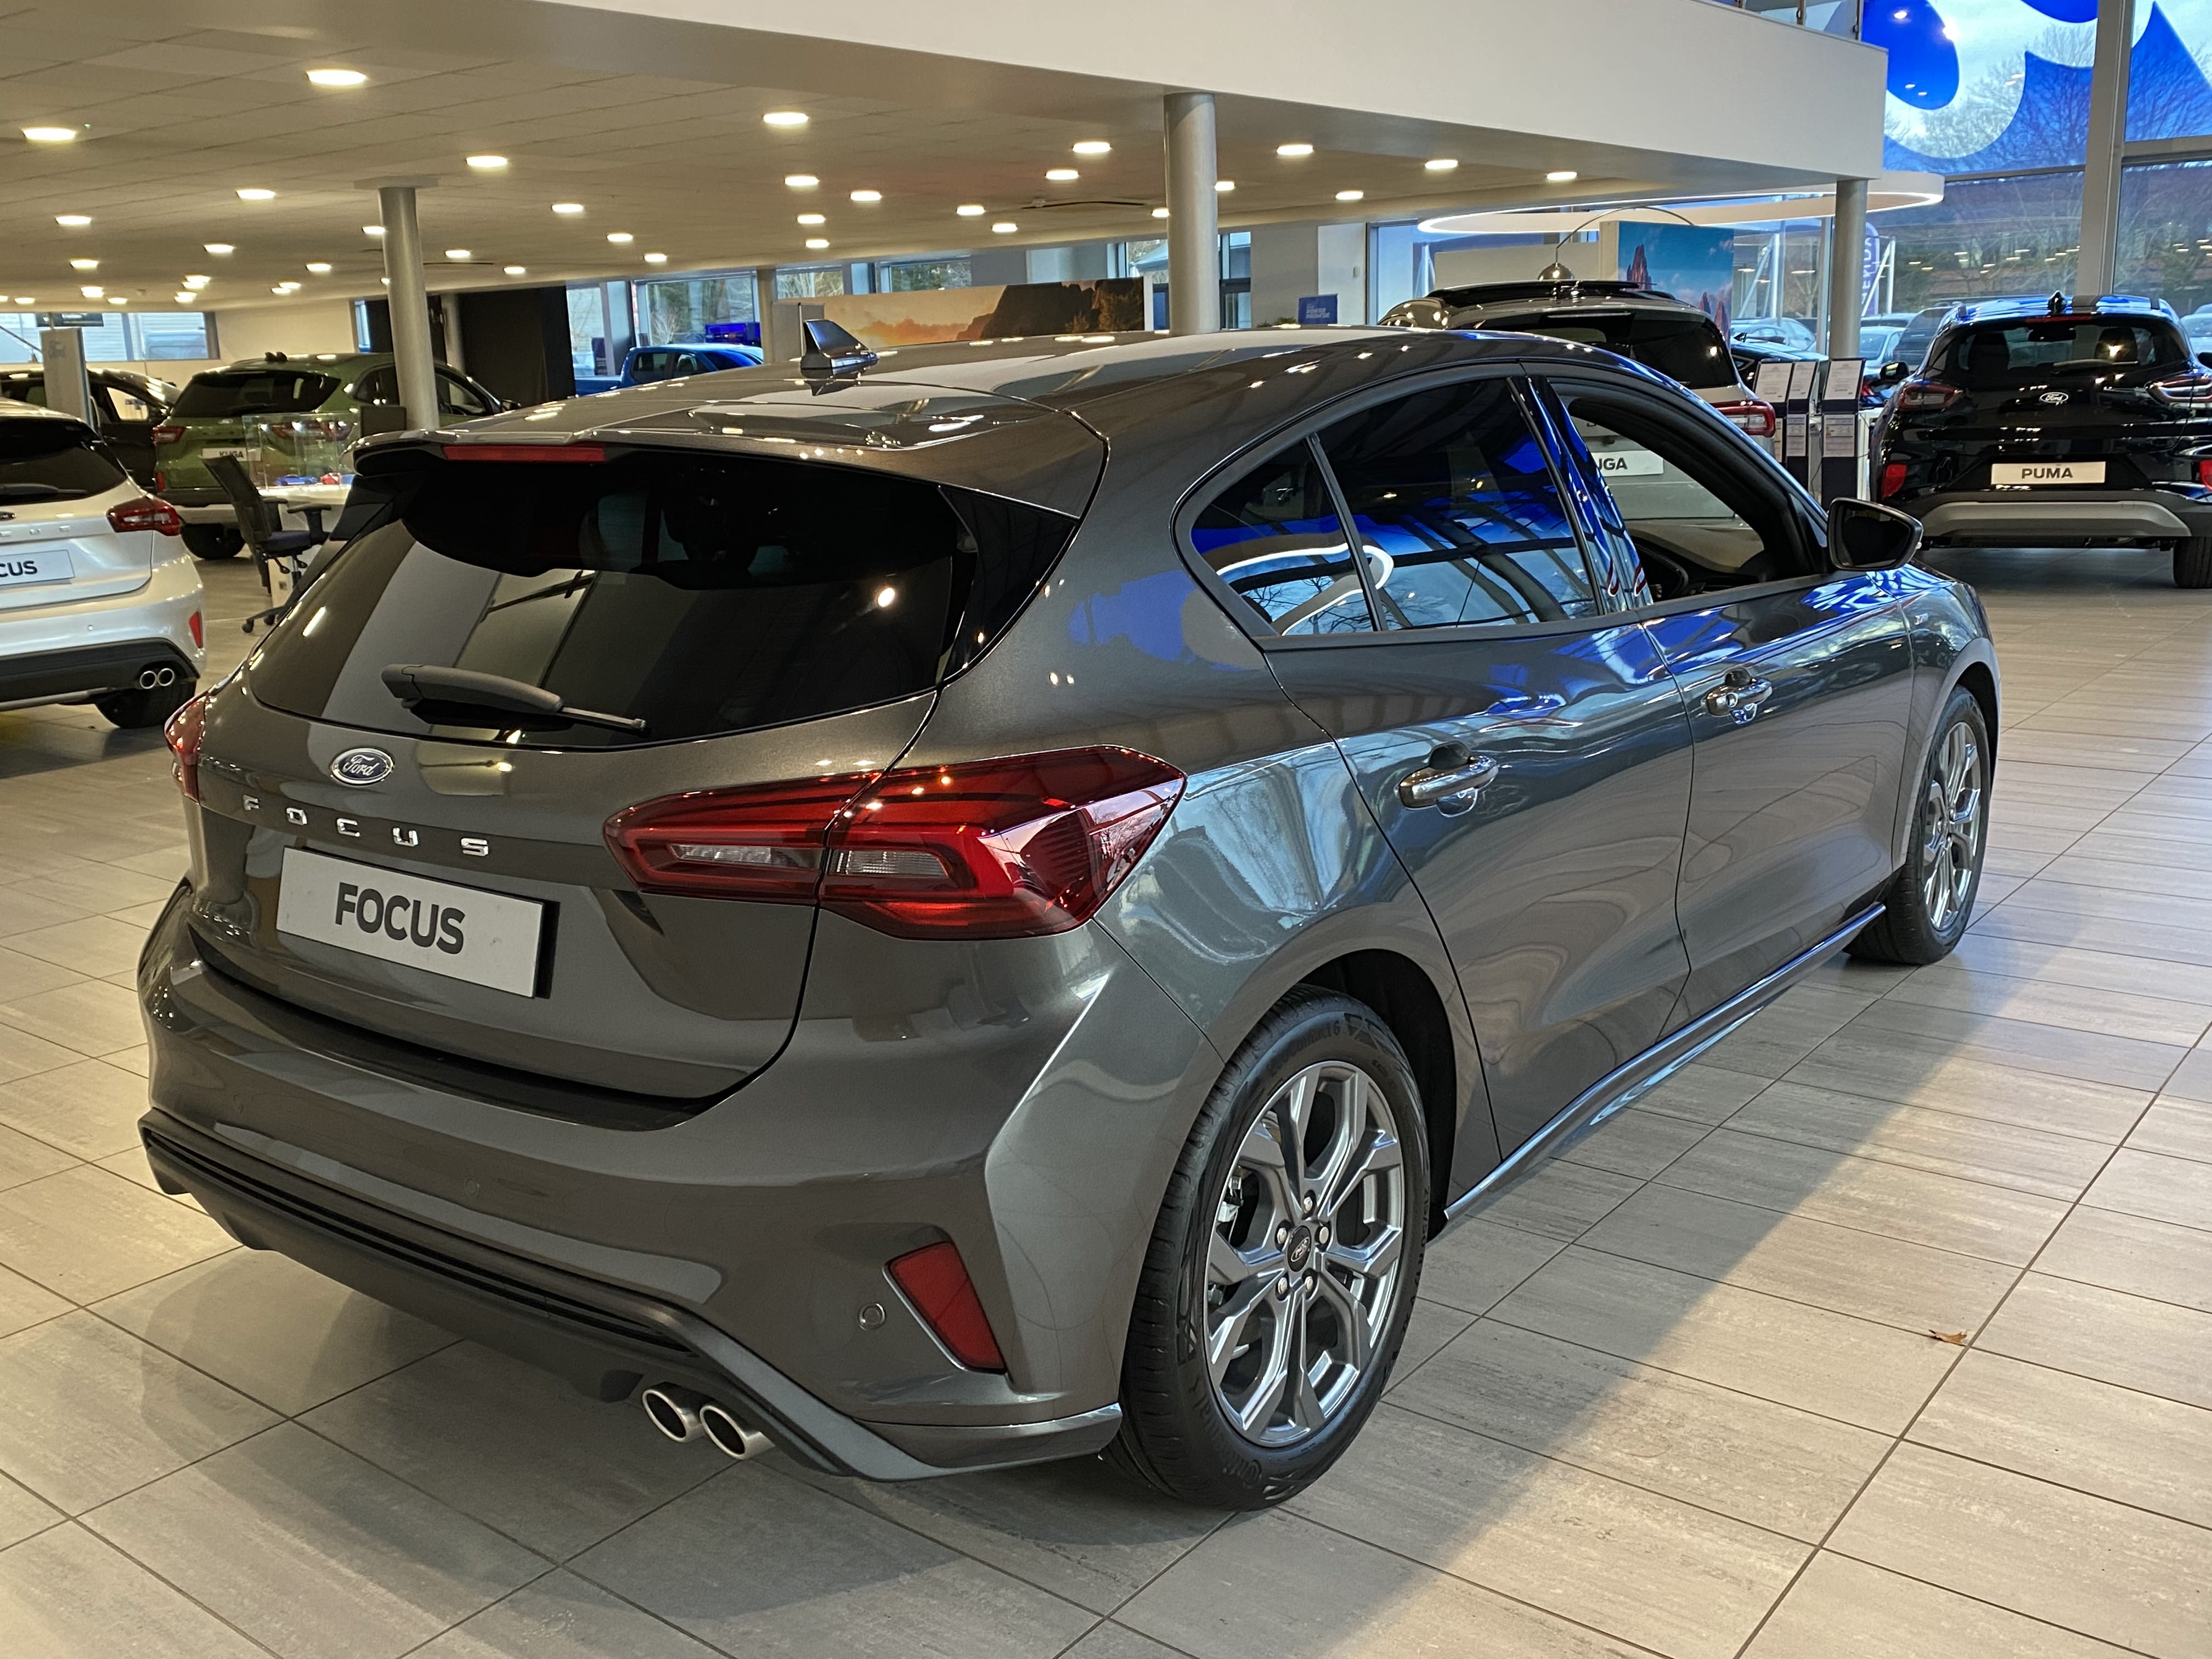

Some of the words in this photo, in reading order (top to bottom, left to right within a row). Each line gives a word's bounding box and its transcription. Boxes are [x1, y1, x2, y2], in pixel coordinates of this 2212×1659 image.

[2022, 467, 2073, 479] PUMA
[243, 794, 489, 856] FOCUS
[335, 882, 465, 954] FOCUS
